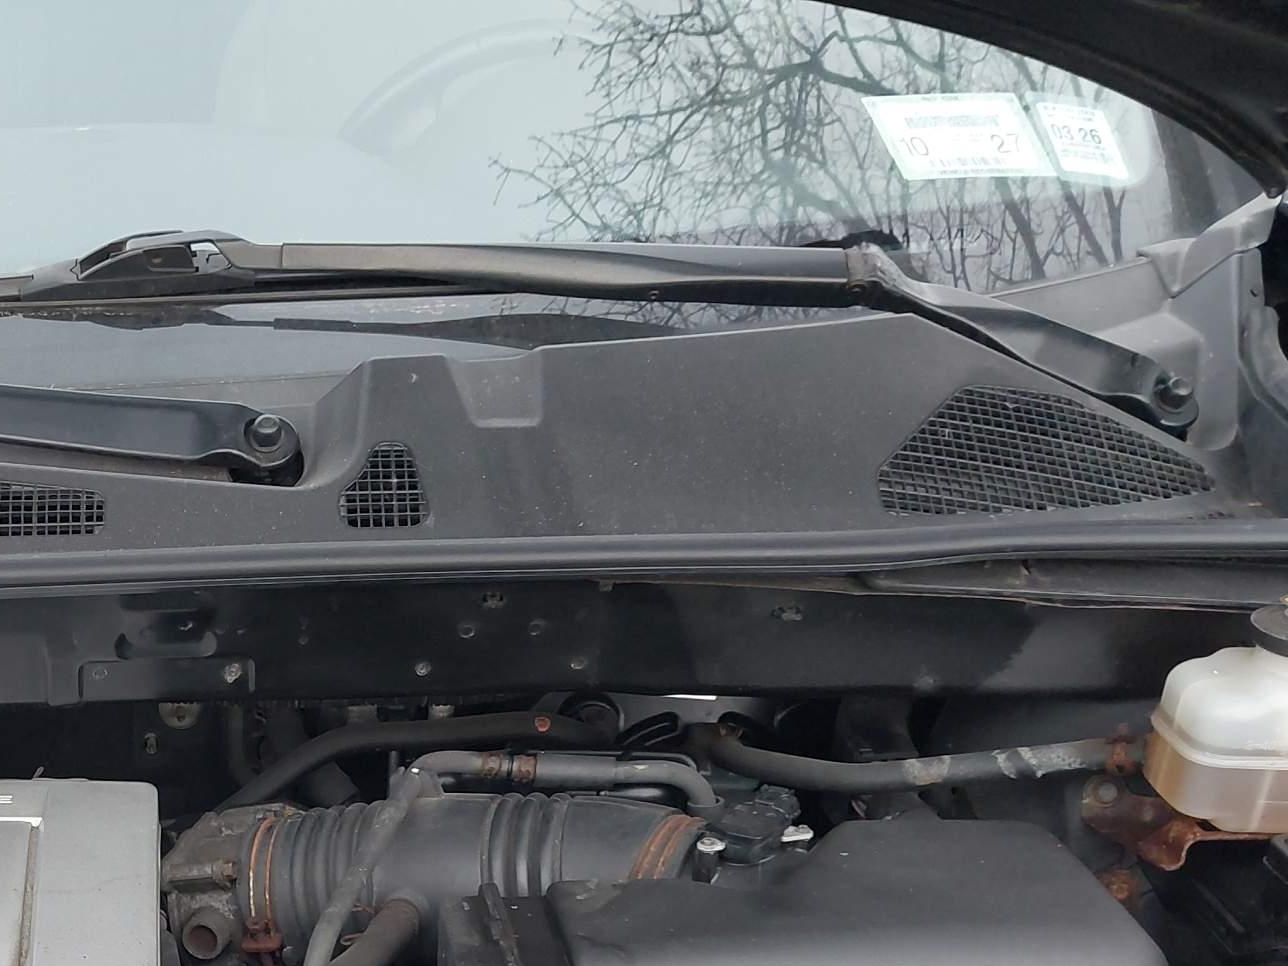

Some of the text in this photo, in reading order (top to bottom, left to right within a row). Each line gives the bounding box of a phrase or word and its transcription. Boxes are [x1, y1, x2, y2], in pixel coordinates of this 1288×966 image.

[991, 133, 1020, 154] 27
[1079, 127, 1102, 145] 26
[900, 137, 929, 157] 10
